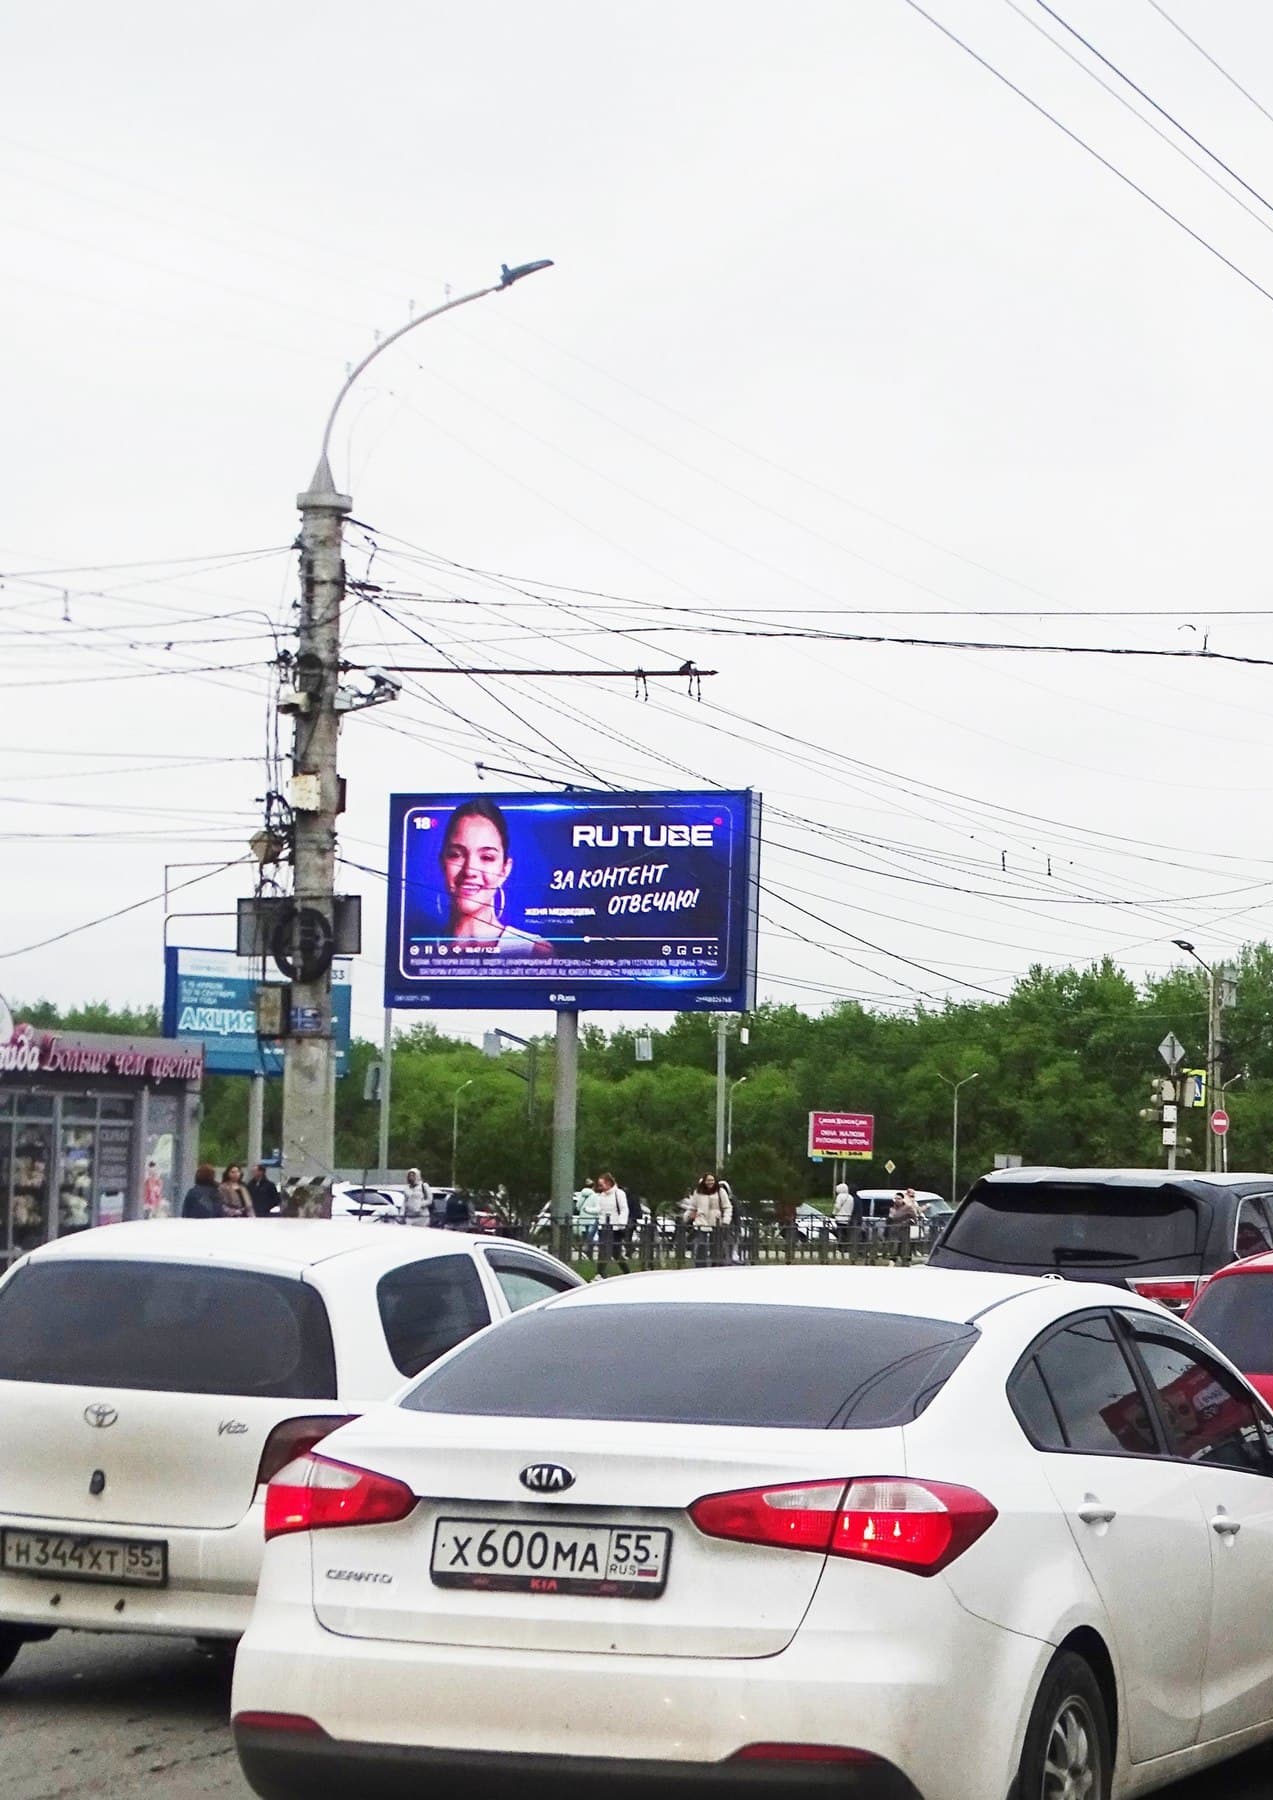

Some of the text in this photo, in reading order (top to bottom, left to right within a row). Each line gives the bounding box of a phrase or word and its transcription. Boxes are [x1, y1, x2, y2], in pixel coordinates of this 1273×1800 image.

[572, 824, 714, 848] RUTUBE
[550, 864, 669, 890] ЗА КОНТЕНТ
[607, 888, 700, 915] ОТВЕЧАЮ!
[177, 1006, 256, 1035] АКЦИЯ
[115, 1053, 147, 1076] чем
[525, 1467, 565, 1487] KIA
[15, 1537, 154, 1573] Н344ХТ 55
[449, 1528, 653, 1574] Х600МА 55
[608, 1564, 637, 1576] RUS
[529, 1578, 558, 1592] KIA
